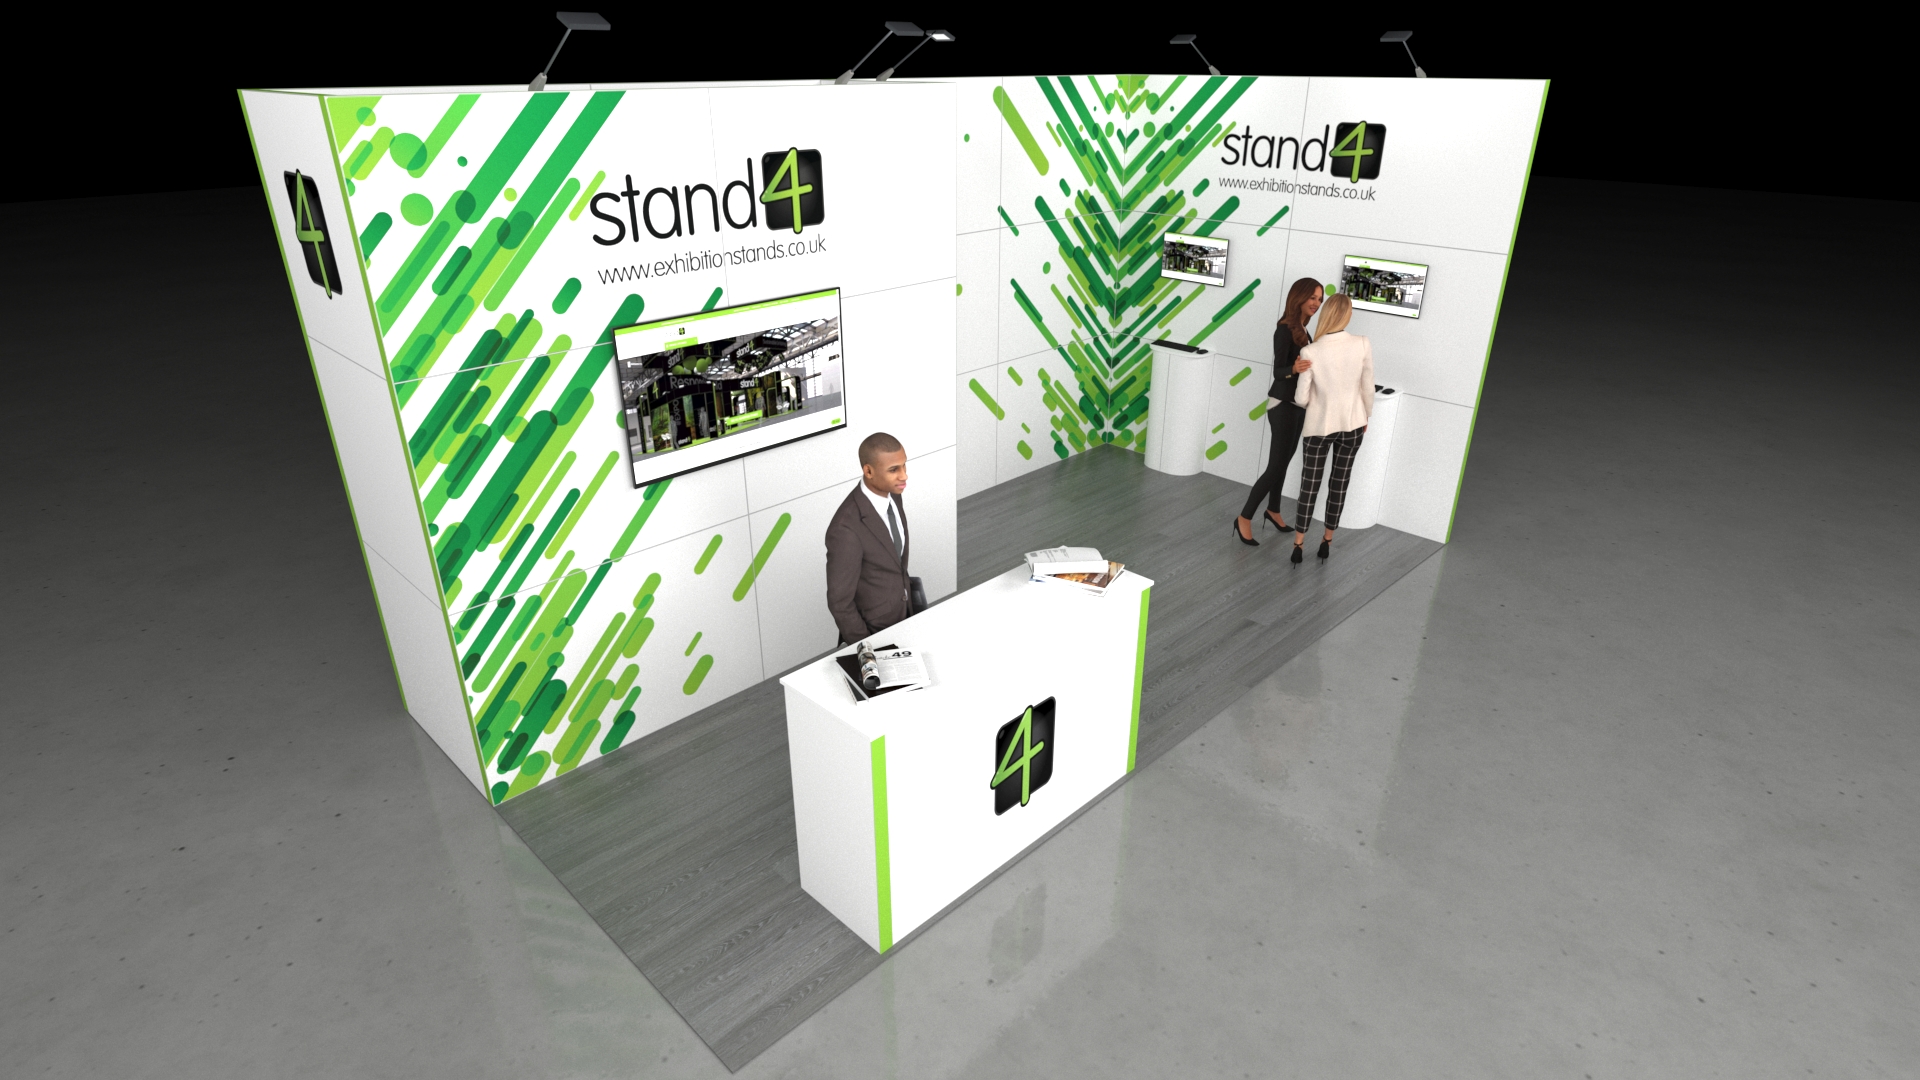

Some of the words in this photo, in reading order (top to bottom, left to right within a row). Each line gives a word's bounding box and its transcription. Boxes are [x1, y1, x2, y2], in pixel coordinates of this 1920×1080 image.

[1218, 176, 1376, 201] www.exhibitionstands.co.uk
[1221, 120, 1376, 183] stand4
[295, 168, 332, 300] 4
[590, 147, 815, 246] stand4
[598, 234, 826, 285] www.exhibitionstands.co.uk
[990, 705, 1045, 807] 4
